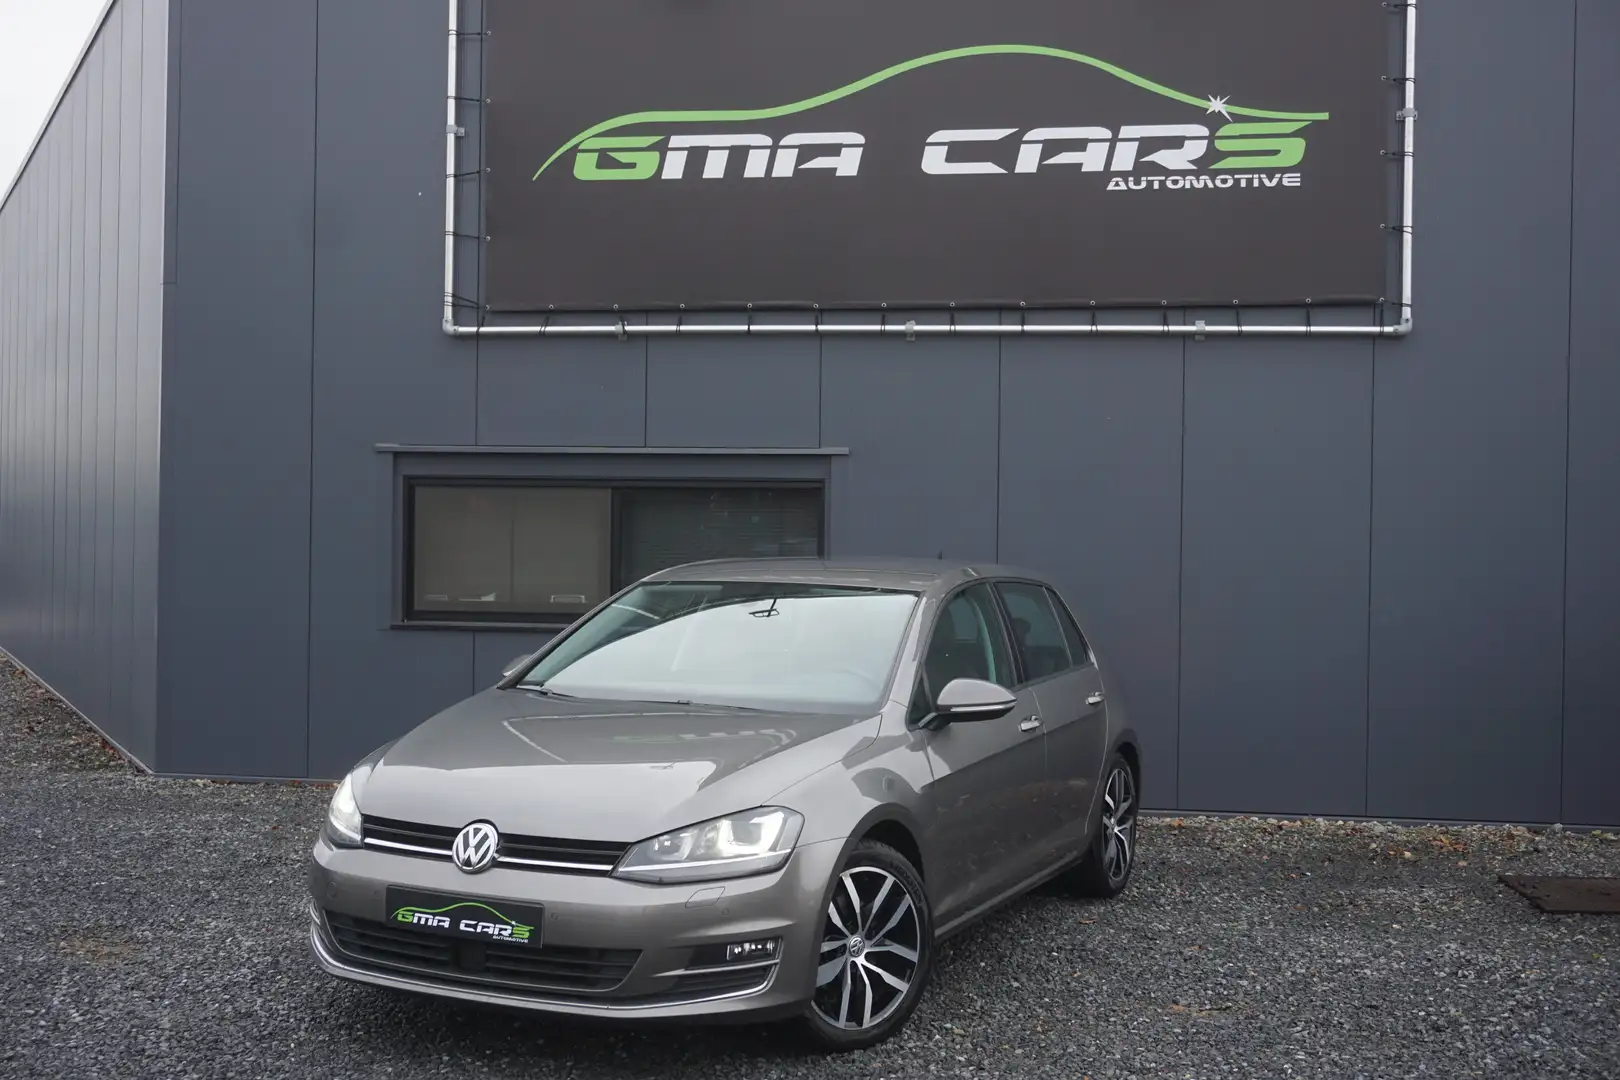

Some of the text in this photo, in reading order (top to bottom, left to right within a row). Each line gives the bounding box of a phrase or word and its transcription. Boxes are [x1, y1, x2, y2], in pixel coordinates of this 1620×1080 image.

[573, 120, 1314, 182] GMA CARS
[1105, 172, 1302, 192] AUTOMOTIVE
[397, 911, 530, 939] GMA CARS
[492, 935, 529, 943] AUTOMOTIVE
